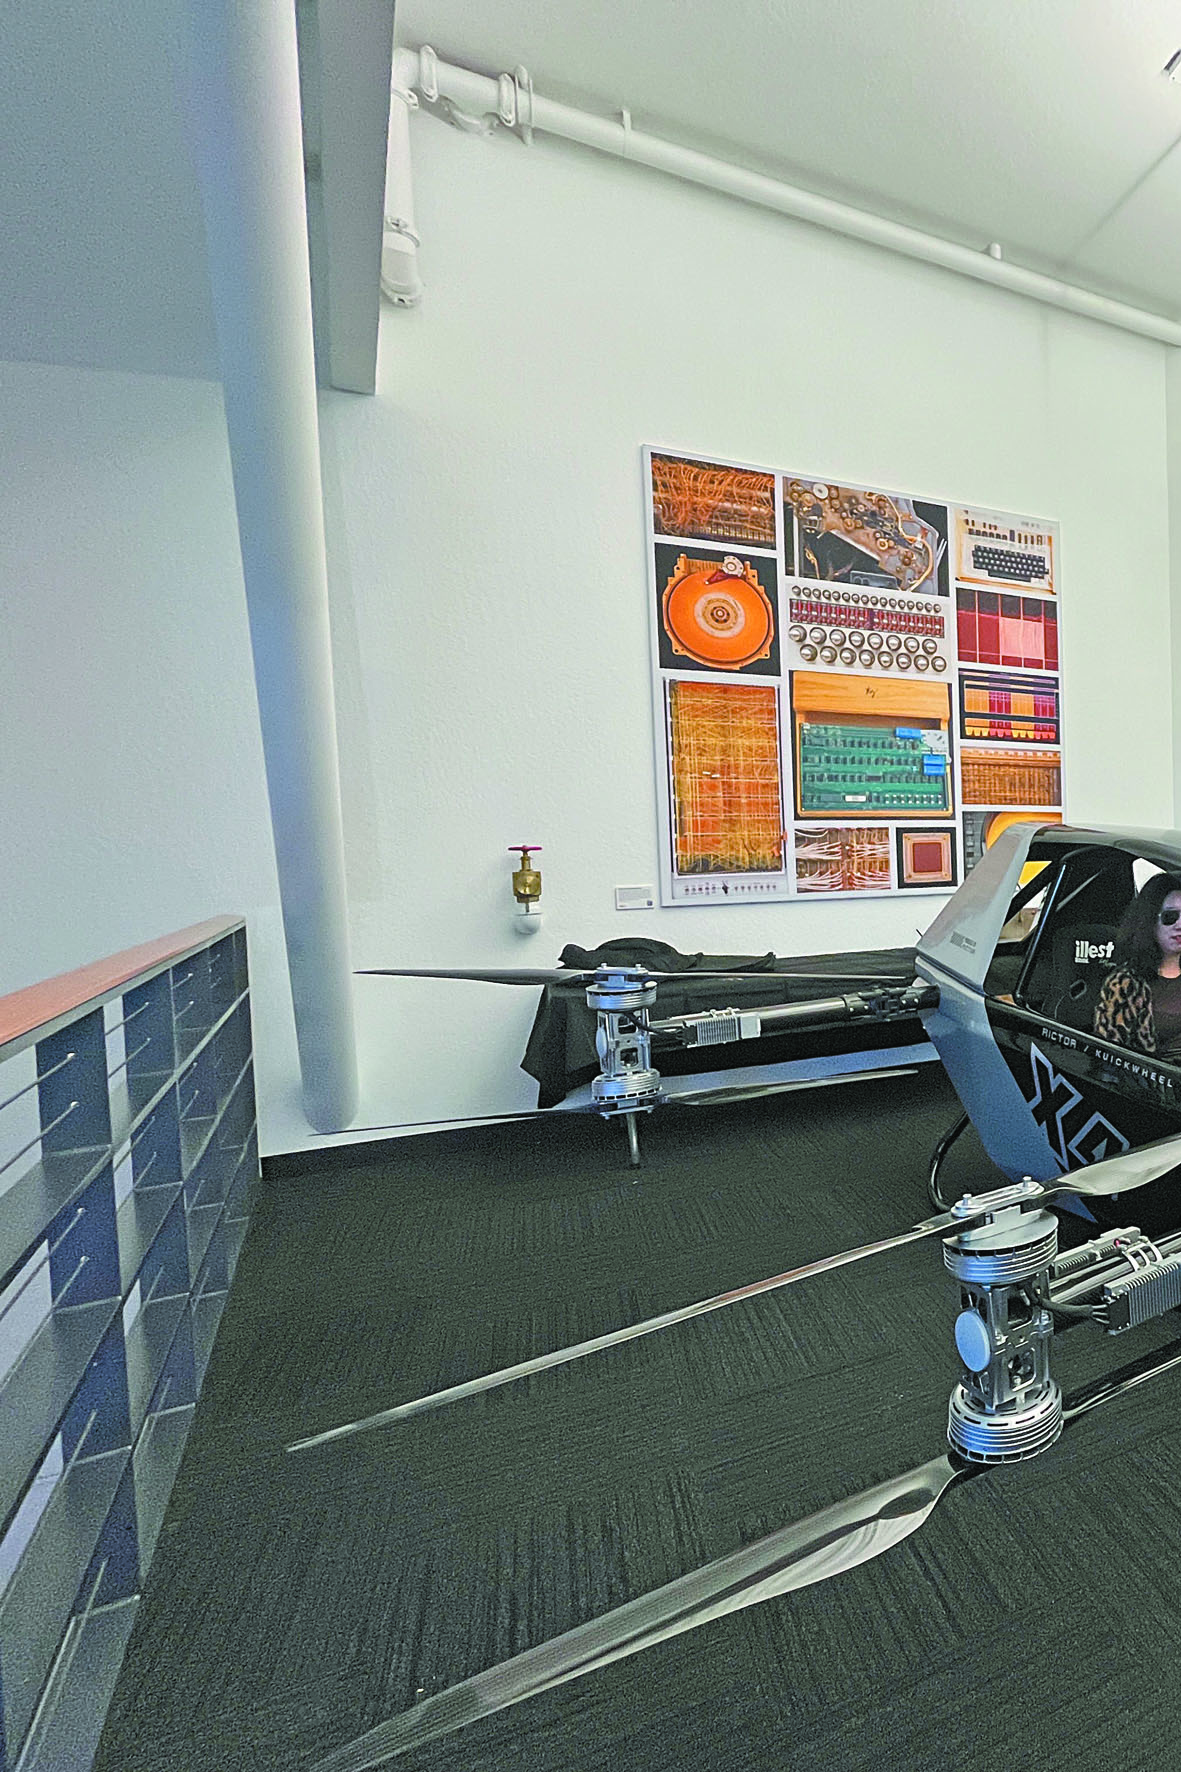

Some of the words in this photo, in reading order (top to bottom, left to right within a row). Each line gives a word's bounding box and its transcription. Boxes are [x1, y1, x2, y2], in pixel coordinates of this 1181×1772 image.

[1075, 940, 1115, 958] illest
[1041, 1027, 1077, 1049] RICTOR
[1095, 1049, 1173, 1088] KUICKWHEEL
